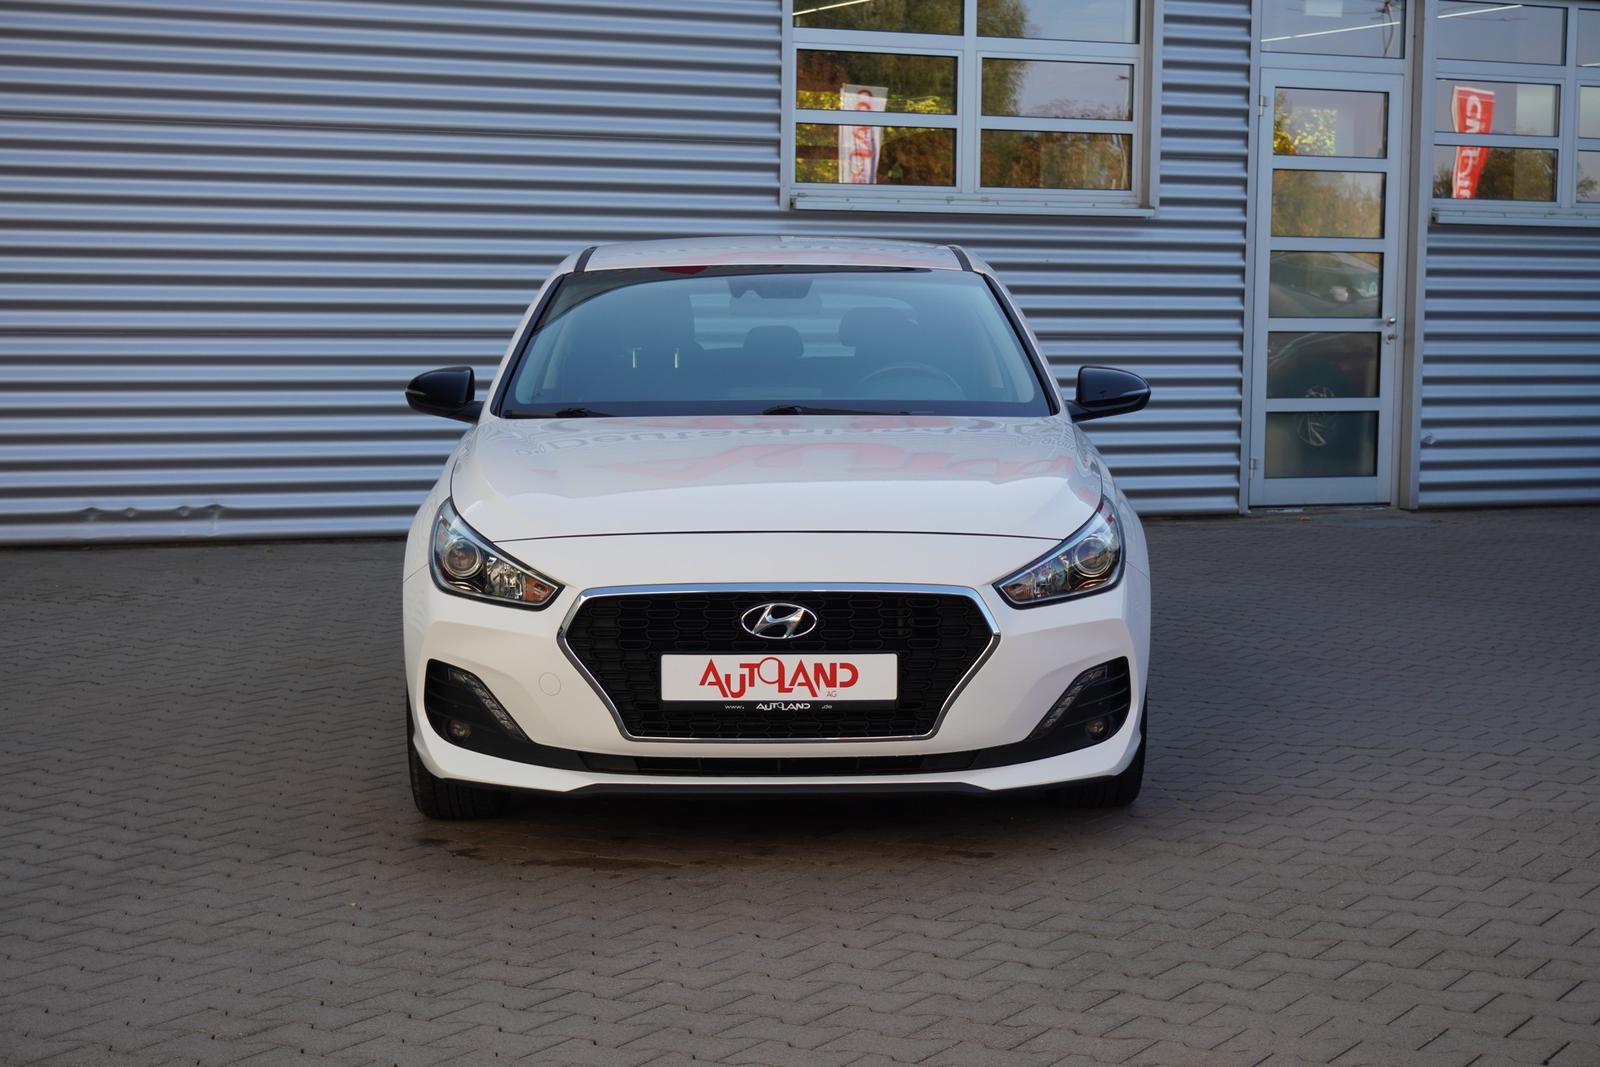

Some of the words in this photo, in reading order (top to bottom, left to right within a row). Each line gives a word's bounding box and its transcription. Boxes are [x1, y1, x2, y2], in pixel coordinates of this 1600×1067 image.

[699, 656, 859, 698] AUTOLAND
[826, 690, 837, 698] AG
[756, 701, 811, 711] AUTOLAND
